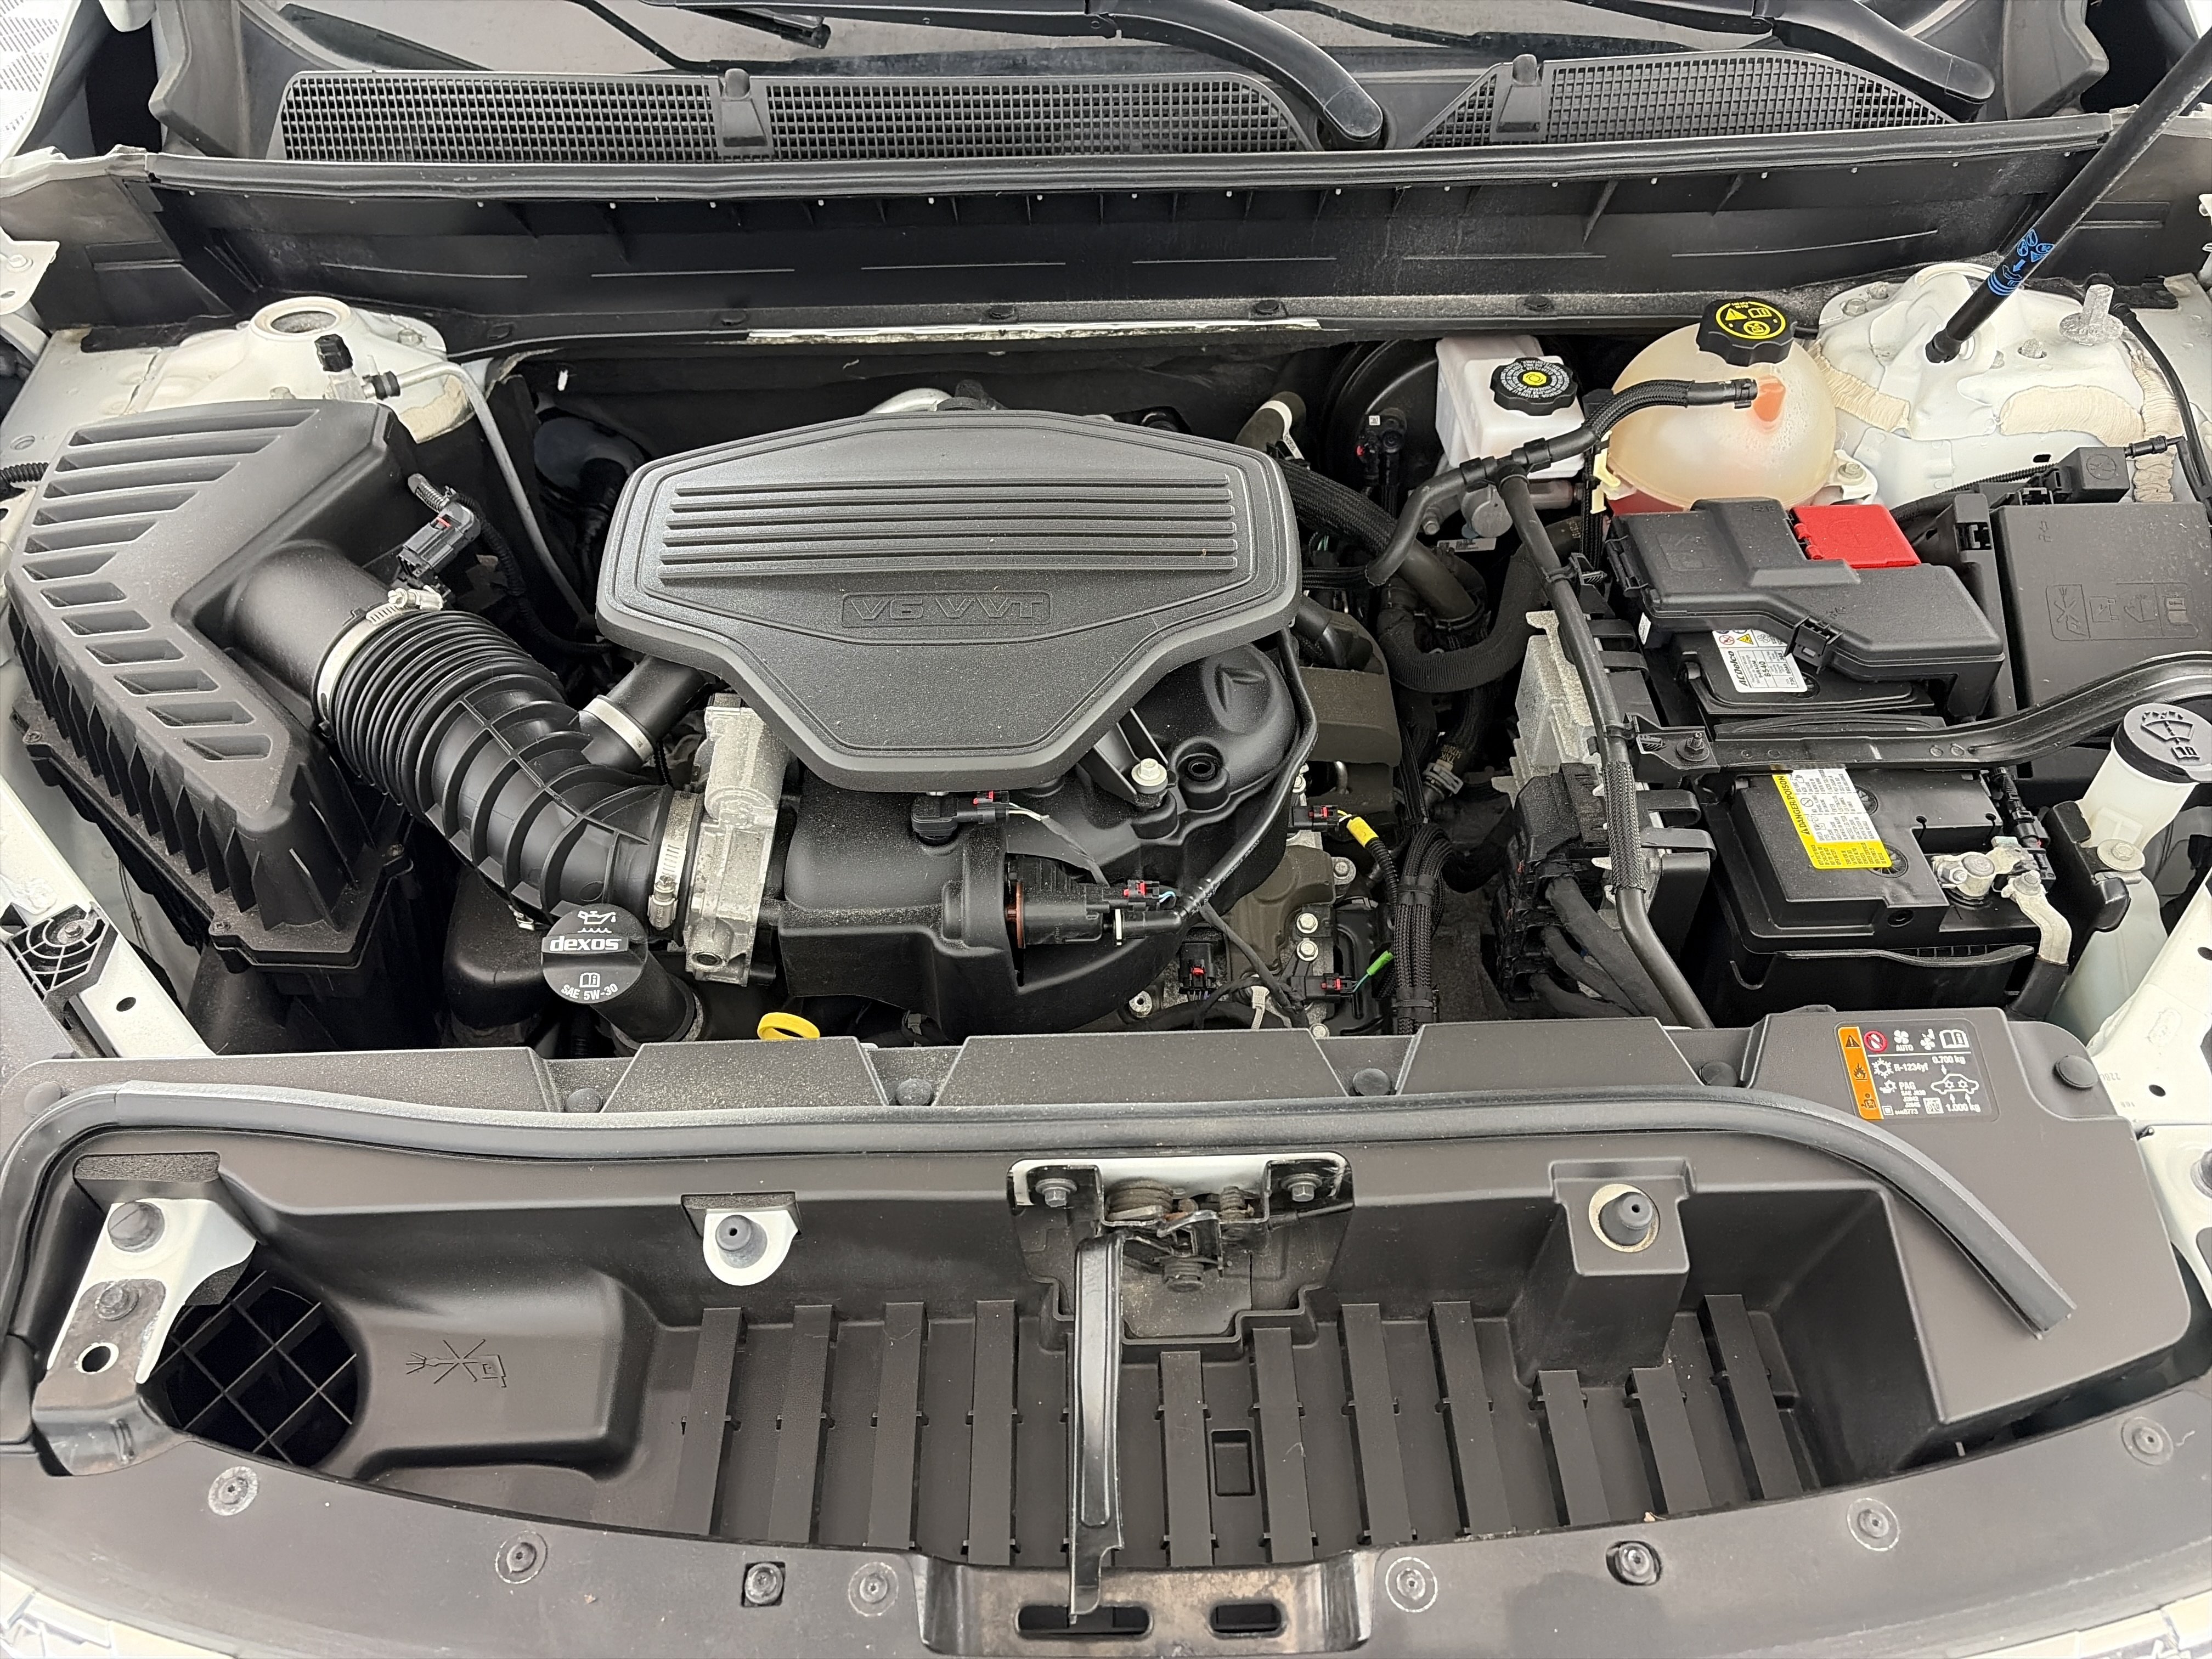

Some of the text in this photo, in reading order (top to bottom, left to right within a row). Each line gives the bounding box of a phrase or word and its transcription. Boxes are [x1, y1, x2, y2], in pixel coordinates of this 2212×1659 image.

[851, 597, 1044, 620] V6 VVT
[1728, 651, 1748, 686] ACDelco
[1758, 661, 1771, 676] 8540
[1787, 677, 1796, 685] 730
[1776, 775, 1808, 828] DANGER/POISON
[550, 935, 619, 951] dexos
[561, 984, 618, 1001] SAE 5W-30
[1893, 1062, 1928, 1072] R-1234yf
[1954, 1055, 1966, 1064] kg
[1899, 1081, 1916, 1090] PAG
[1945, 1103, 1981, 1113] 1.000 kg
